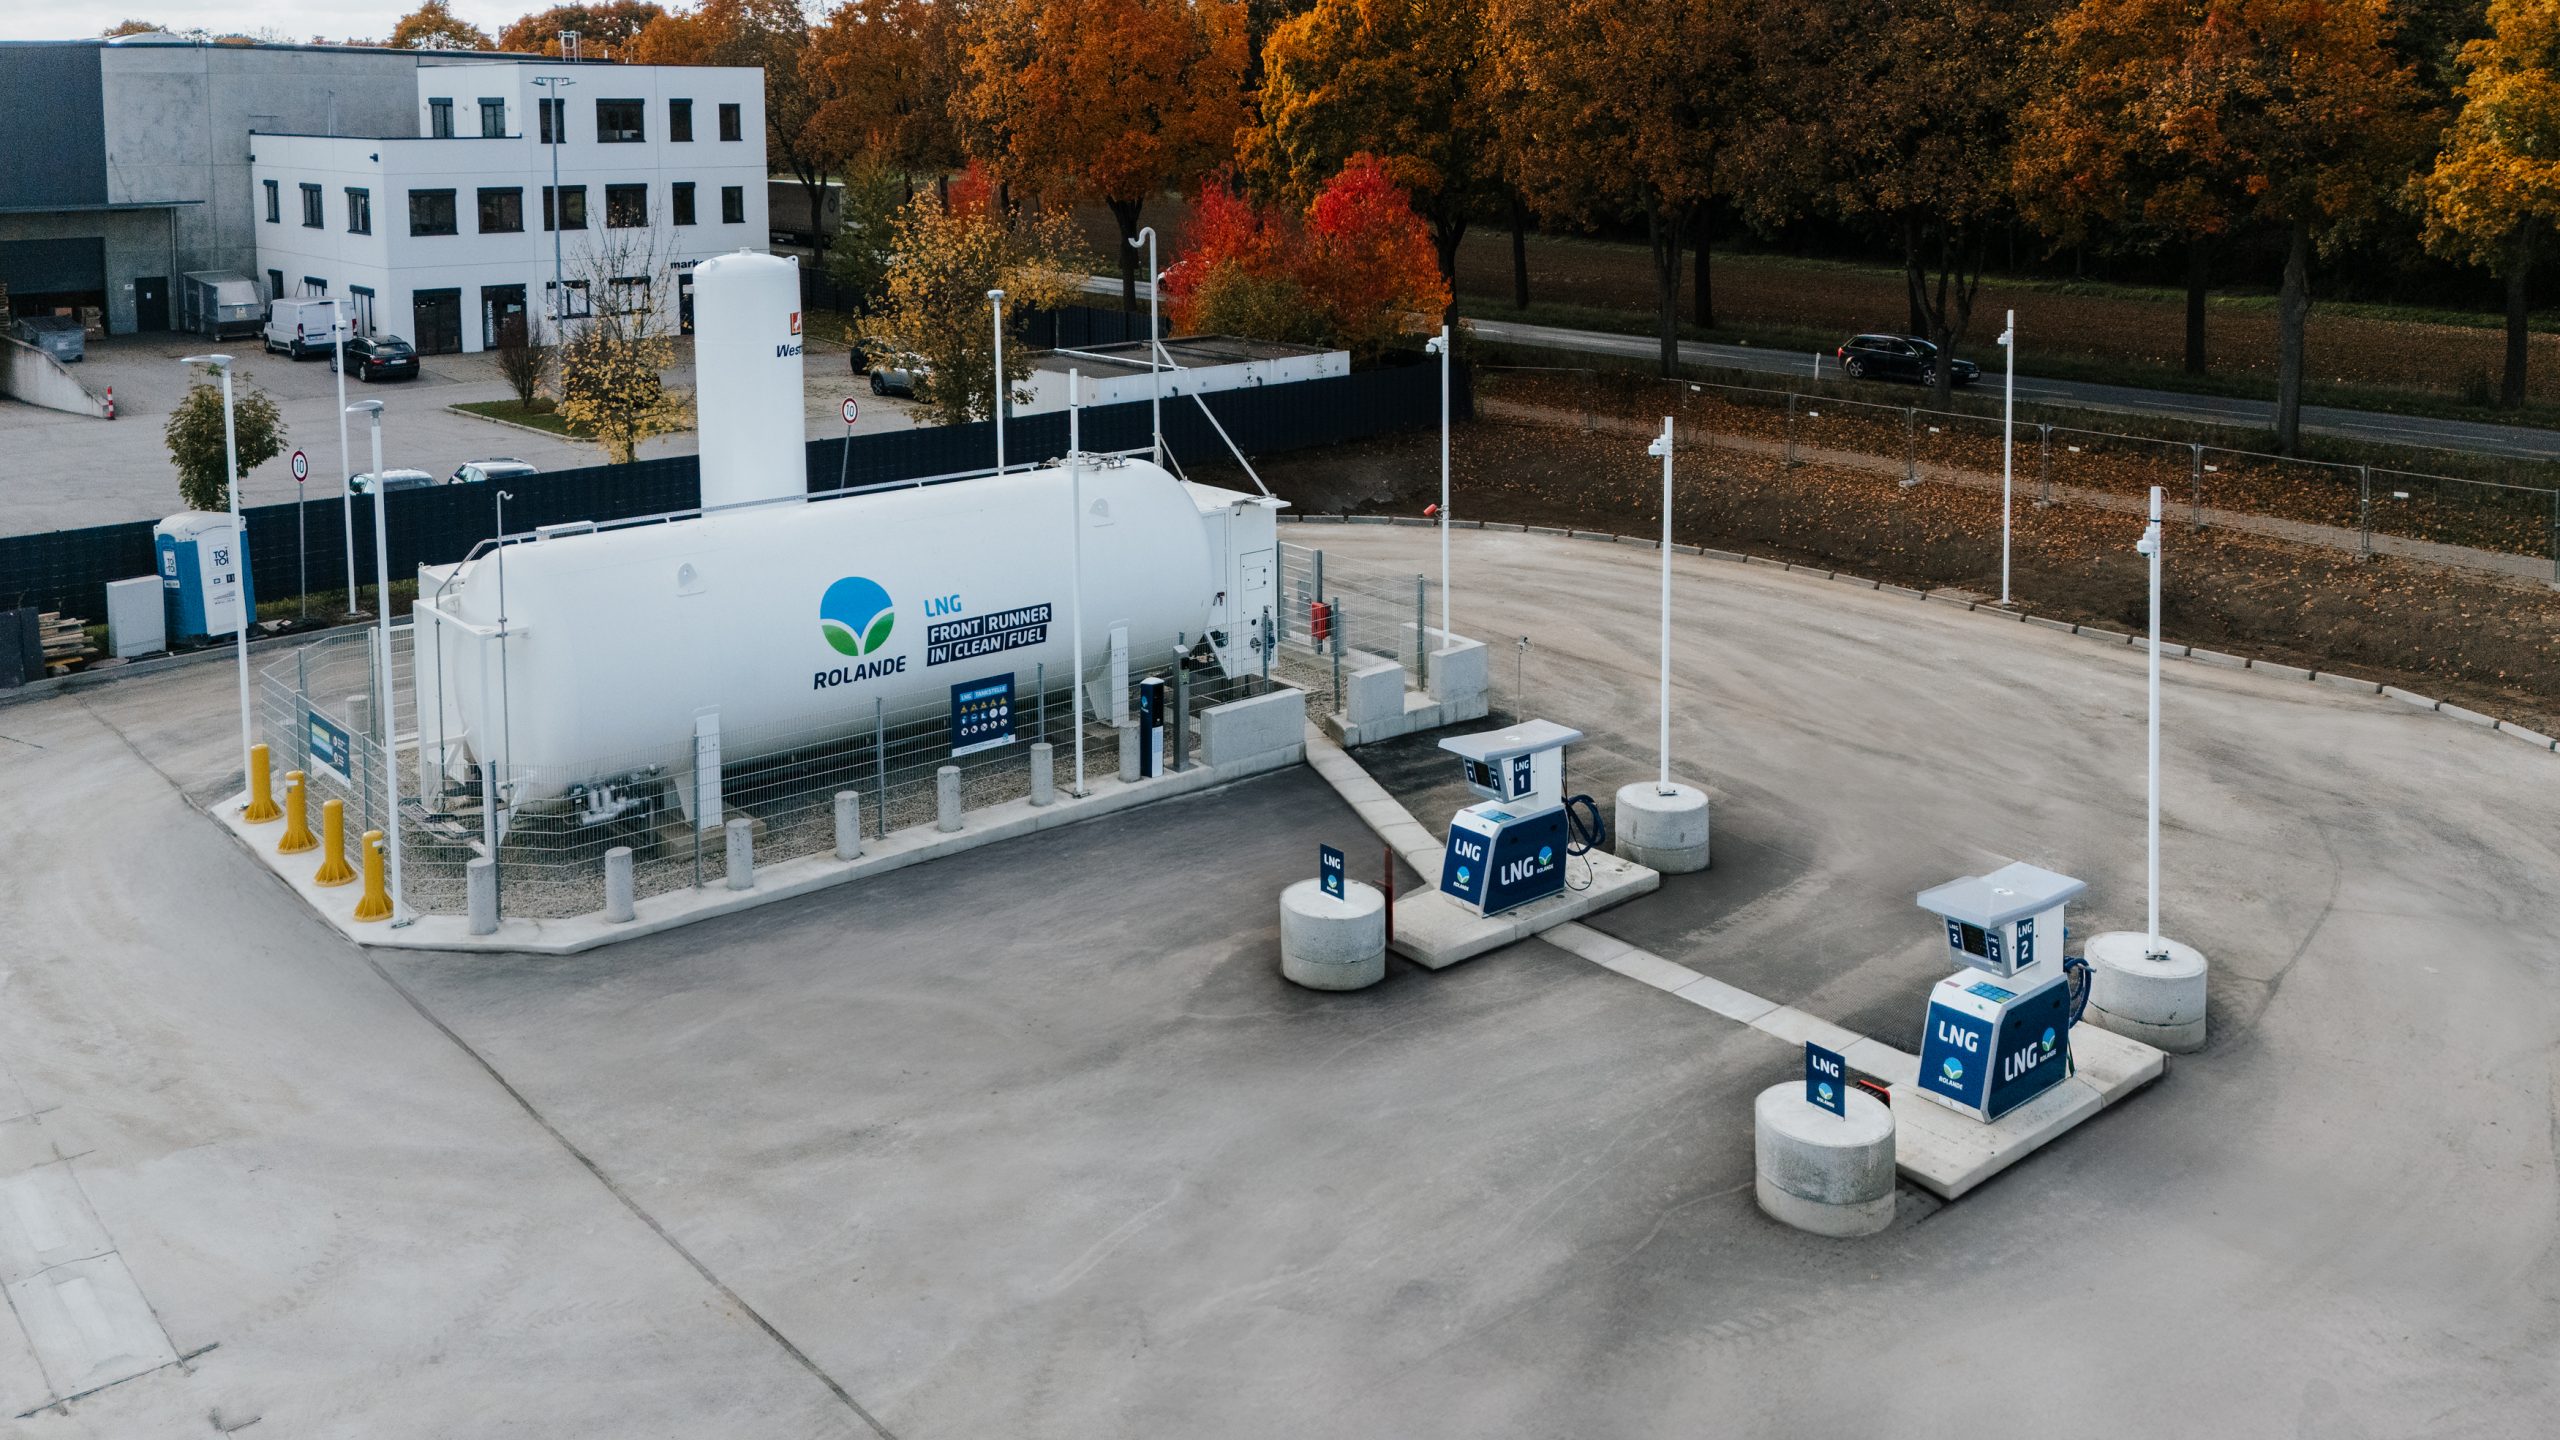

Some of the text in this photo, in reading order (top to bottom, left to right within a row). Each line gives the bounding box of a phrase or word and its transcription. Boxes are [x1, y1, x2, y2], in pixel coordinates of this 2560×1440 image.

[846, 404, 855, 417] 10
[296, 458, 305, 474] 10
[924, 594, 962, 617] LNG
[930, 606, 1049, 643] FRONT RUNNER
[930, 628, 1044, 664] IN CLEAN FUEL
[813, 655, 906, 690] ROLANDE
[1515, 759, 1529, 772] LNG
[1519, 774, 1524, 789] 1
[1455, 838, 1481, 861] LNG
[1324, 853, 1340, 870] LNG
[1501, 856, 1533, 886] LNG
[1952, 933, 1959, 943] 2
[2018, 922, 2032, 938] LNG
[1991, 946, 1998, 957] 2
[2021, 940, 2029, 960] 2
[1938, 1020, 1979, 1053] LNG
[1812, 1054, 1839, 1078] LNG
[2004, 1041, 2037, 1082] LNG
[1938, 1075, 1963, 1091] ROLANDE
